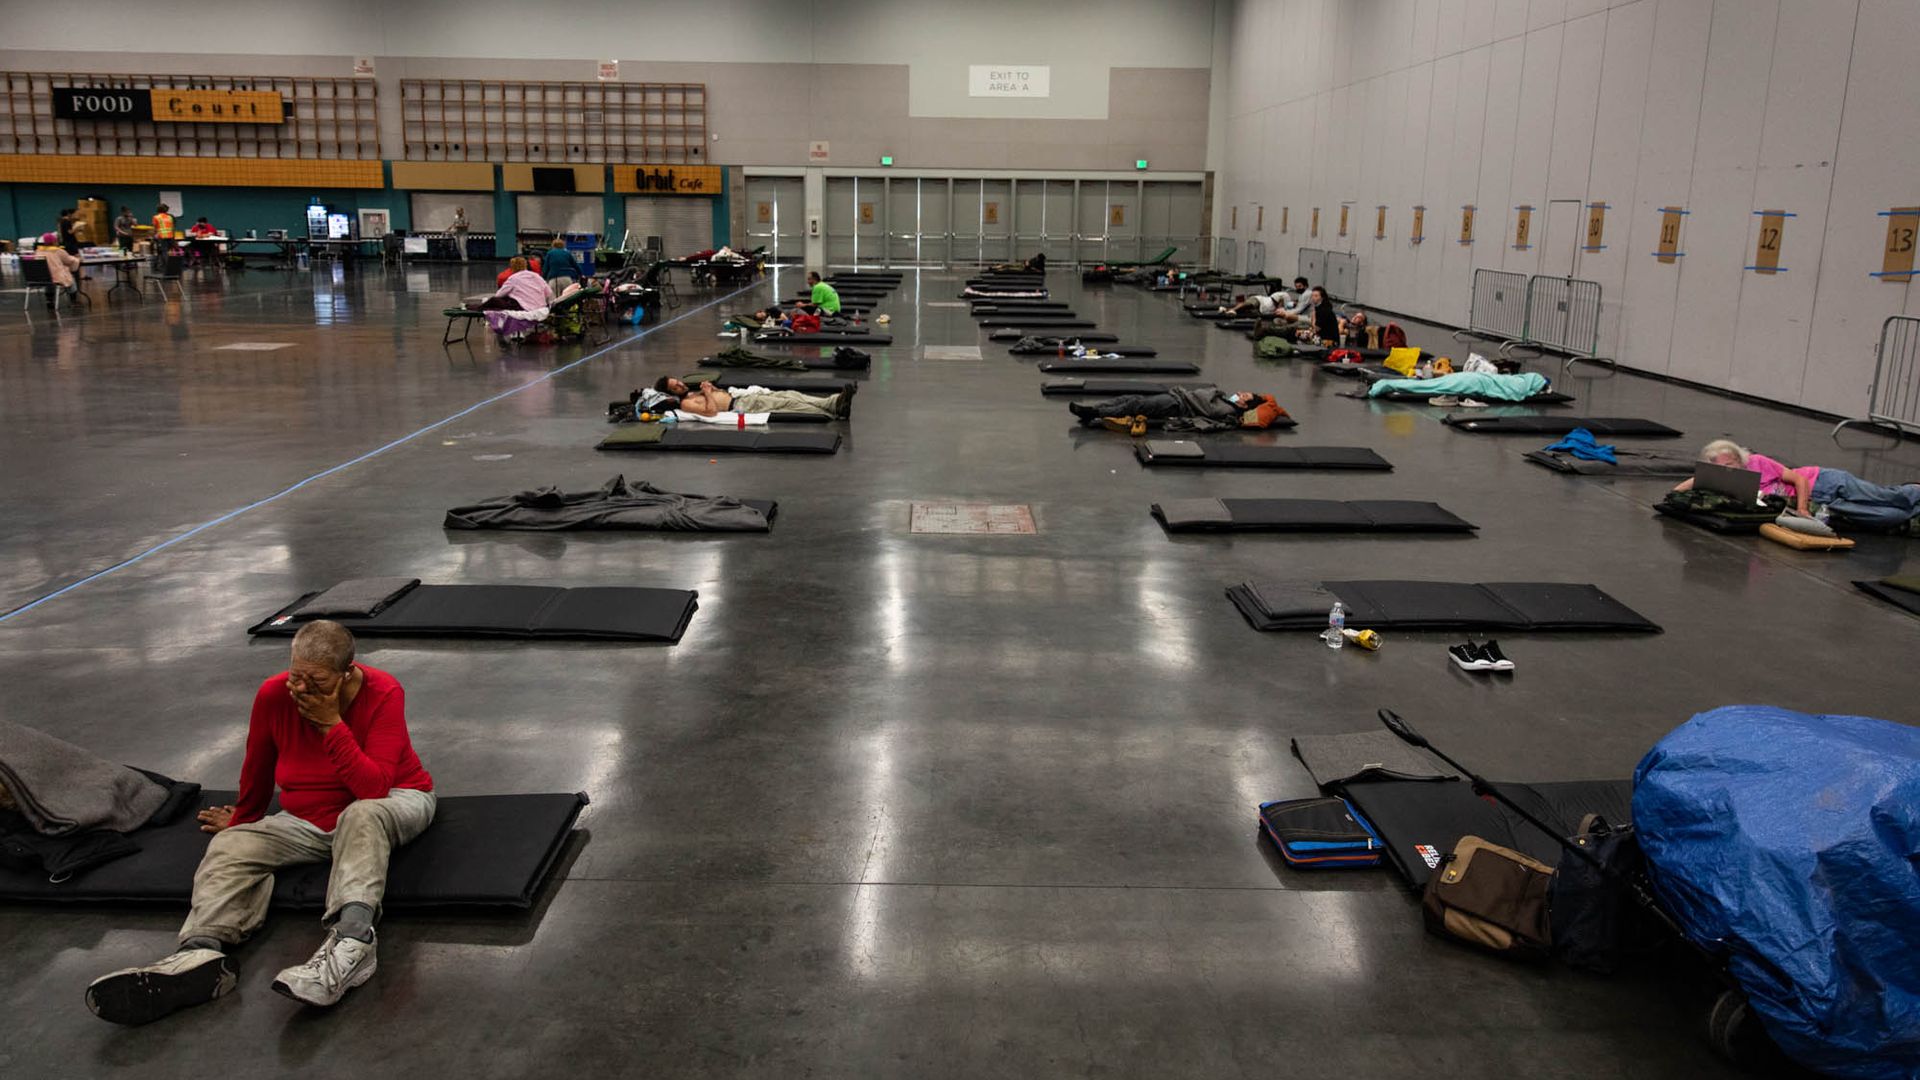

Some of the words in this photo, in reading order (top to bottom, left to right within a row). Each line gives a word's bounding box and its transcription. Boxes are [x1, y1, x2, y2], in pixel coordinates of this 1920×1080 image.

[990, 71, 1011, 80] EXIT
[1016, 71, 1029, 80] TO
[989, 83, 1017, 91] AREA
[1022, 83, 1029, 91] A
[72, 95, 133, 113] FOOD
[169, 97, 257, 114] Court
[636, 168, 676, 191] Orbit
[1589, 217, 1600, 237] 10
[1661, 225, 1674, 244] 11
[1760, 227, 1779, 250] 12
[1889, 228, 1913, 252] 13
[1421, 853, 1437, 869] BED
